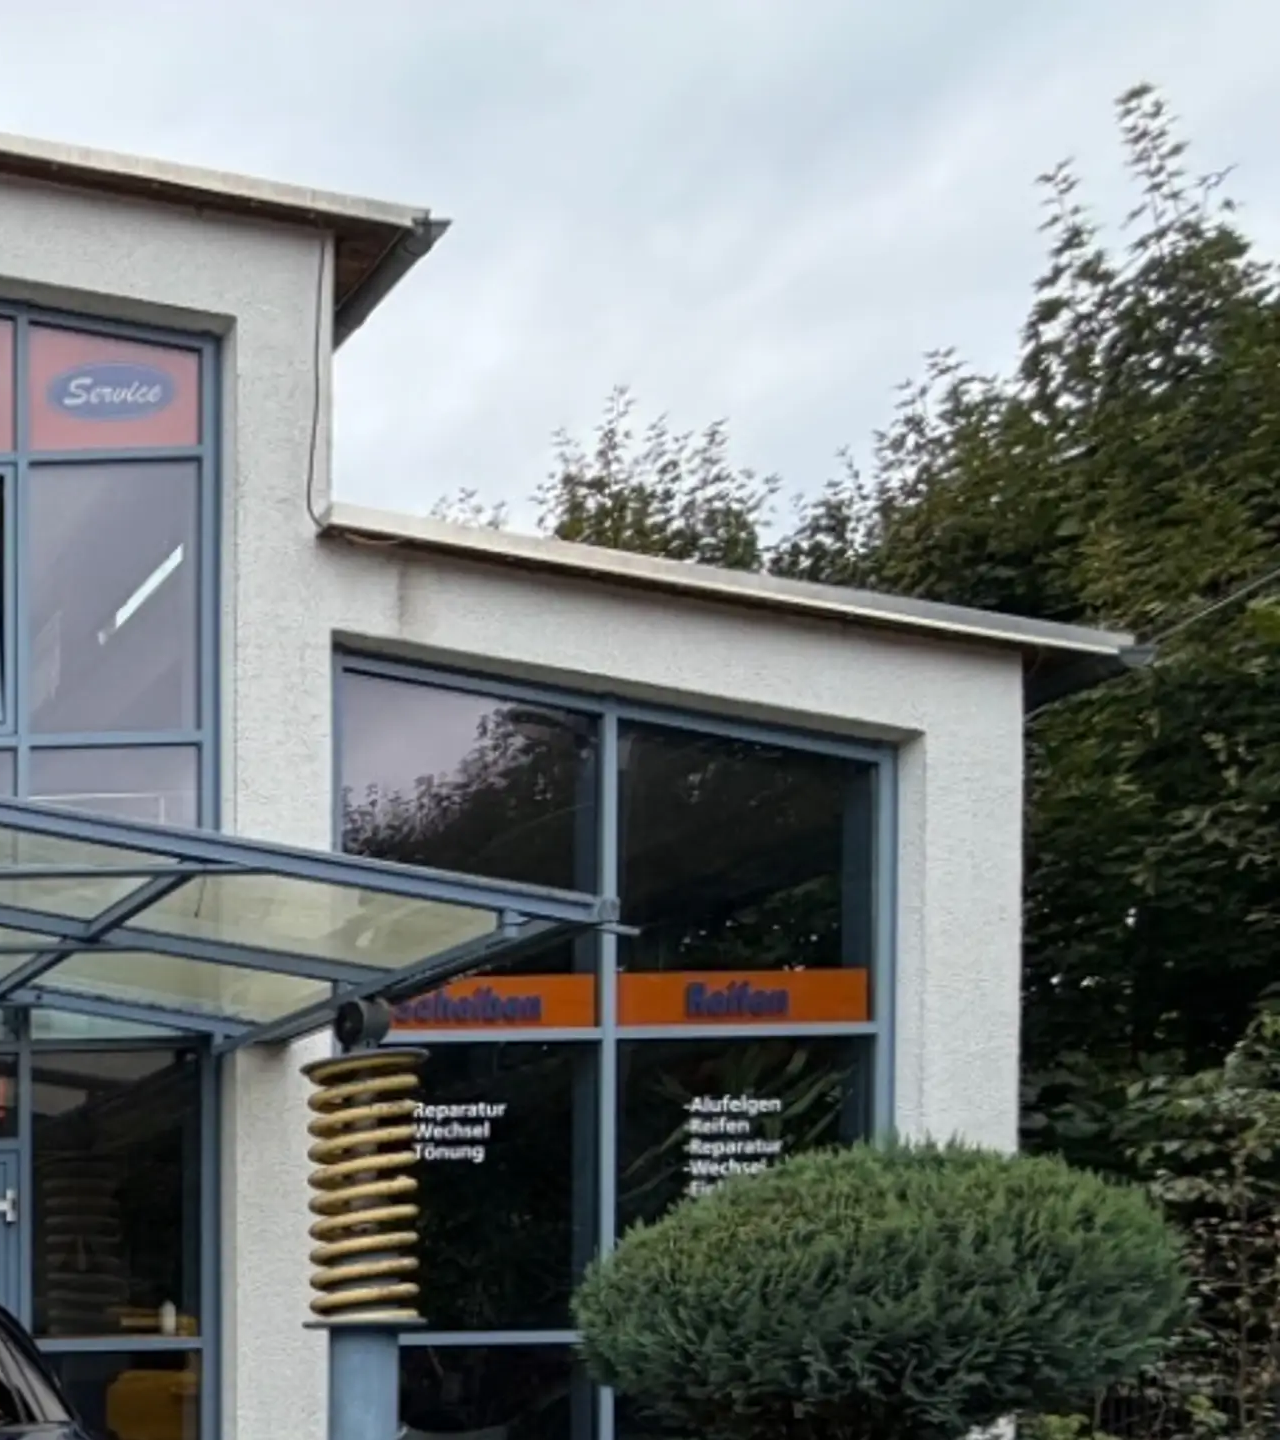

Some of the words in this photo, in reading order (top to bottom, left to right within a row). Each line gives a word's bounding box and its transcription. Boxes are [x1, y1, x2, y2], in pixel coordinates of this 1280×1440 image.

[62, 376, 163, 408] Service
[392, 986, 543, 1020] Scheiben
[686, 980, 789, 1017] Reifen
[412, 1102, 508, 1121] Reparatur
[412, 1121, 491, 1139] Wechsel
[411, 1142, 486, 1163] Tönung
